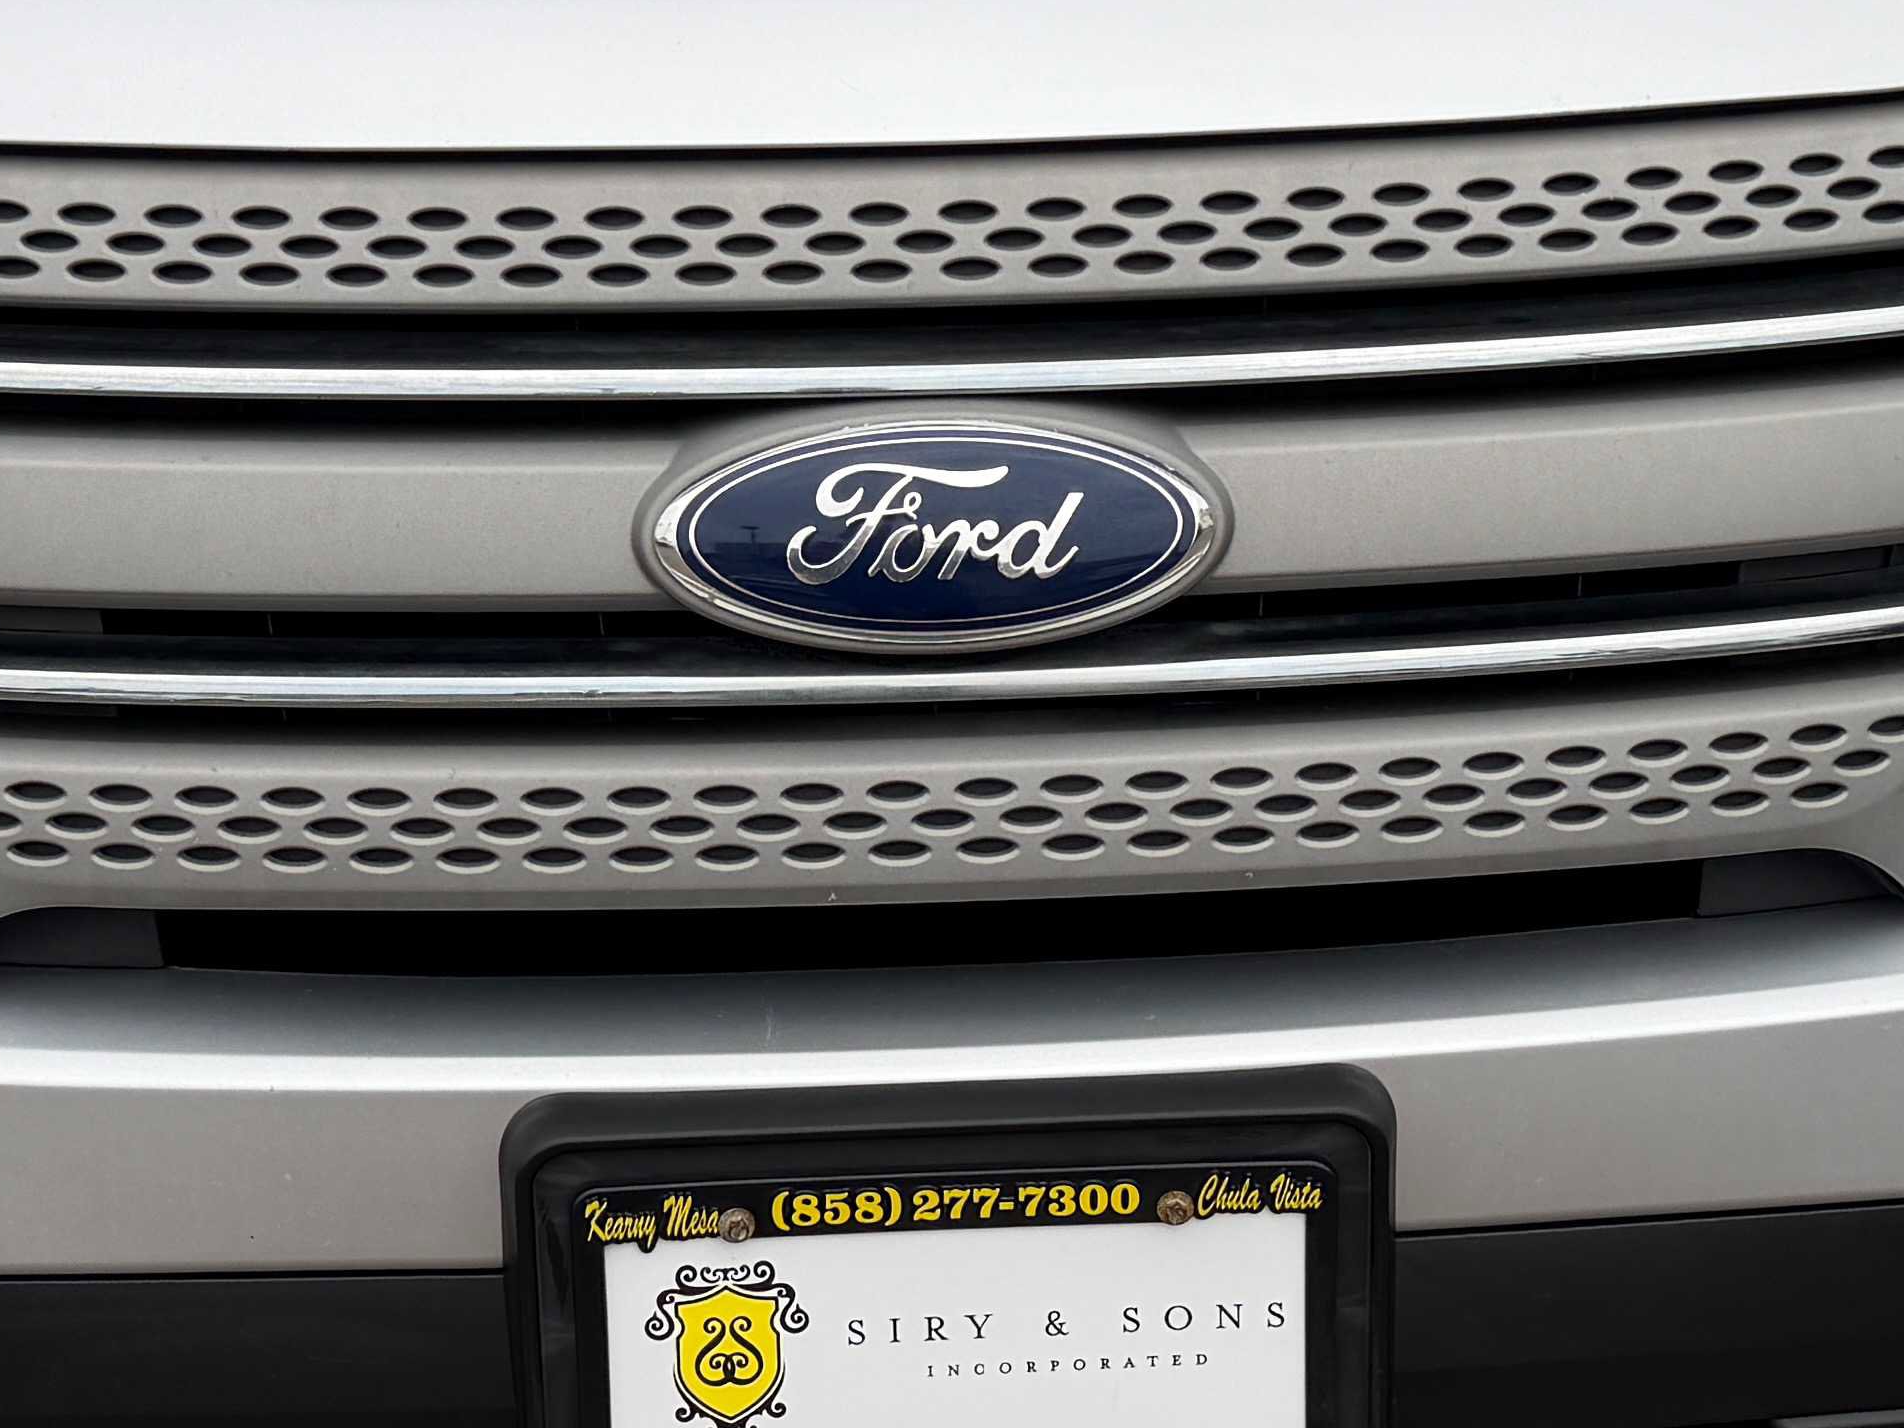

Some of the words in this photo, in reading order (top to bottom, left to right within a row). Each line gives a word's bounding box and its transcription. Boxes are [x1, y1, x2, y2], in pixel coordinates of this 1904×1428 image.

[786, 462, 1084, 584] Ford
[584, 1202, 657, 1251] Kearny
[663, 1194, 719, 1241] Mesa
[771, 1186, 903, 1231] (858)
[912, 1183, 1141, 1223] 277-7300
[1196, 1174, 1261, 1214] Chula
[1268, 1171, 1323, 1210] Vista
[846, 1313, 994, 1347] SIRY
[1045, 1310, 1070, 1338] &
[1121, 1301, 1287, 1335] SONS
[926, 1352, 1211, 1379] INCORPORATED
